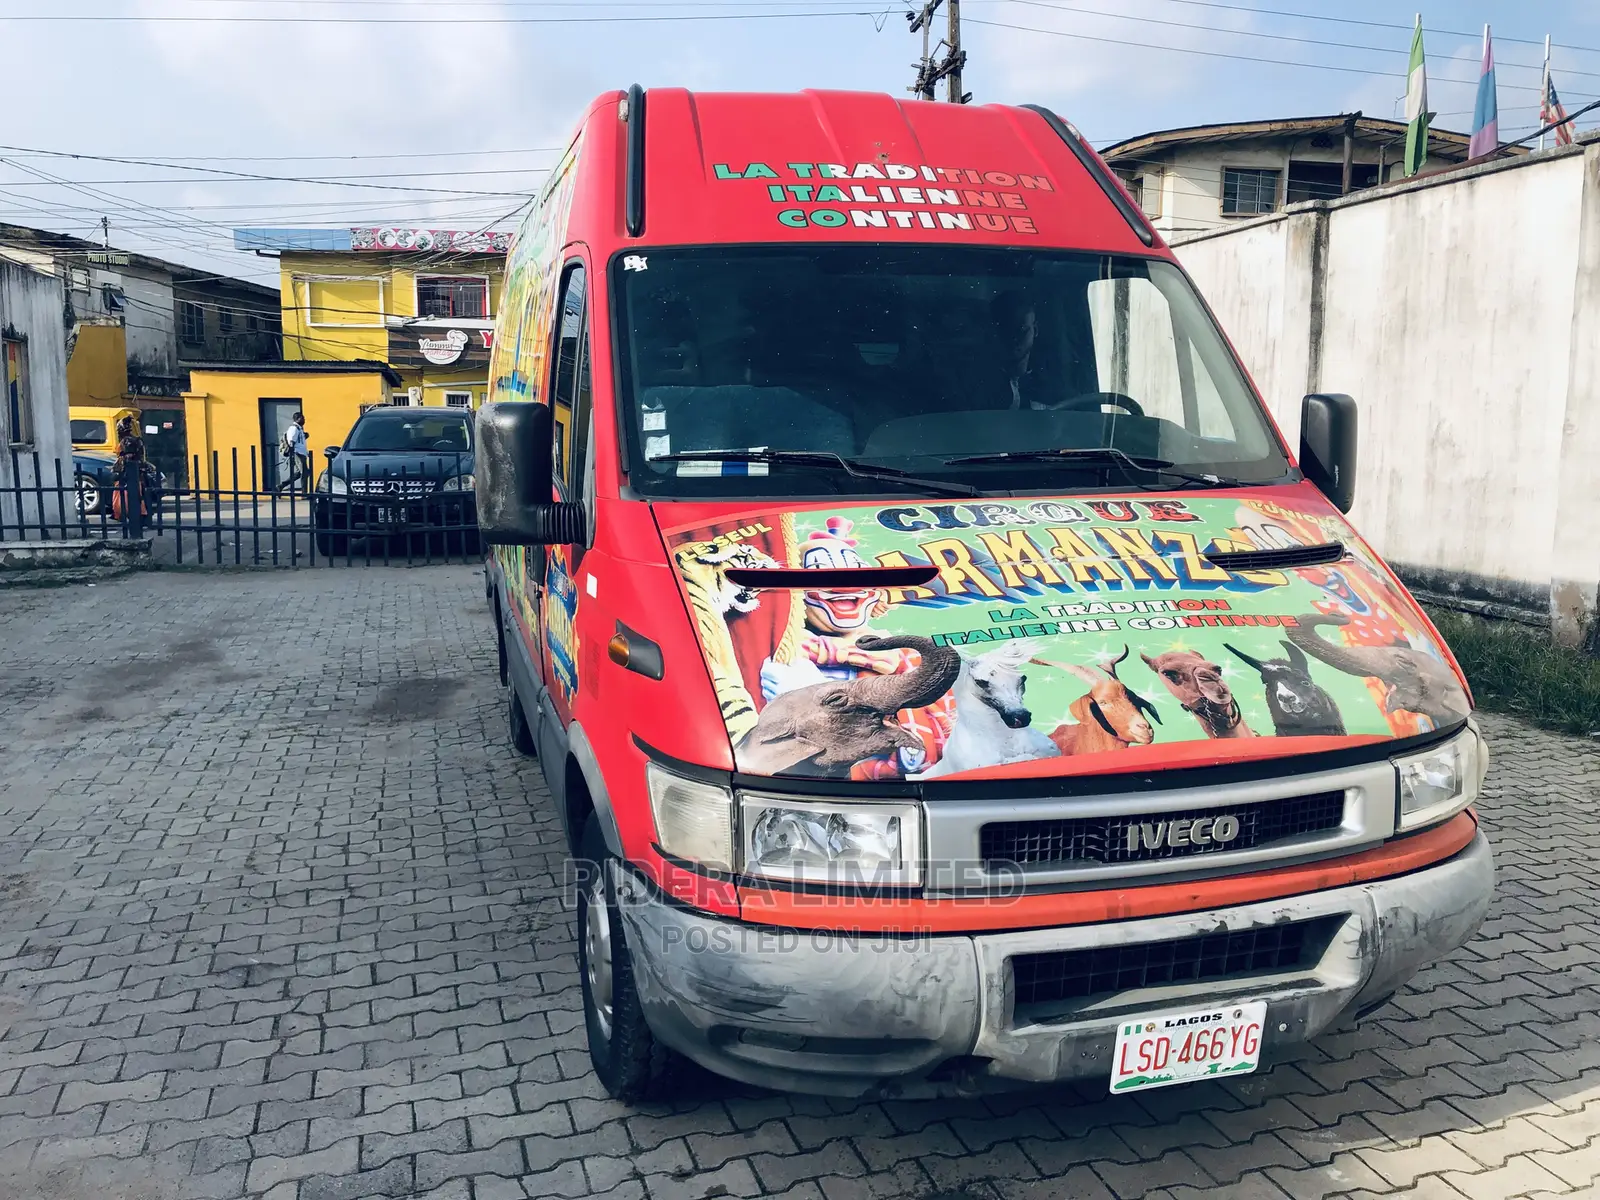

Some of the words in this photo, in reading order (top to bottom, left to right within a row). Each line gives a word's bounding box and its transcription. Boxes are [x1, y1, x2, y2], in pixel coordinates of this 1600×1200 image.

[712, 162, 781, 180] LA
[786, 162, 1055, 191] TRADITION
[766, 184, 1029, 210] ITALIENNE
[777, 208, 1039, 234] CONTINUE
[876, 500, 1206, 532] CIRQUE
[1248, 501, 1340, 531] L'UNIQ
[680, 542, 709, 562] LE
[712, 522, 773, 548] SEUL
[988, 607, 1039, 623] LA
[1041, 599, 1232, 618] TRADITION
[931, 617, 1122, 648] ITALIENNE
[1127, 614, 1301, 631] CONTINUE
[1127, 813, 1240, 853] IVECO
[1164, 1012, 1223, 1028] LAGOS
[1119, 1022, 1260, 1076] LSD-466YG
